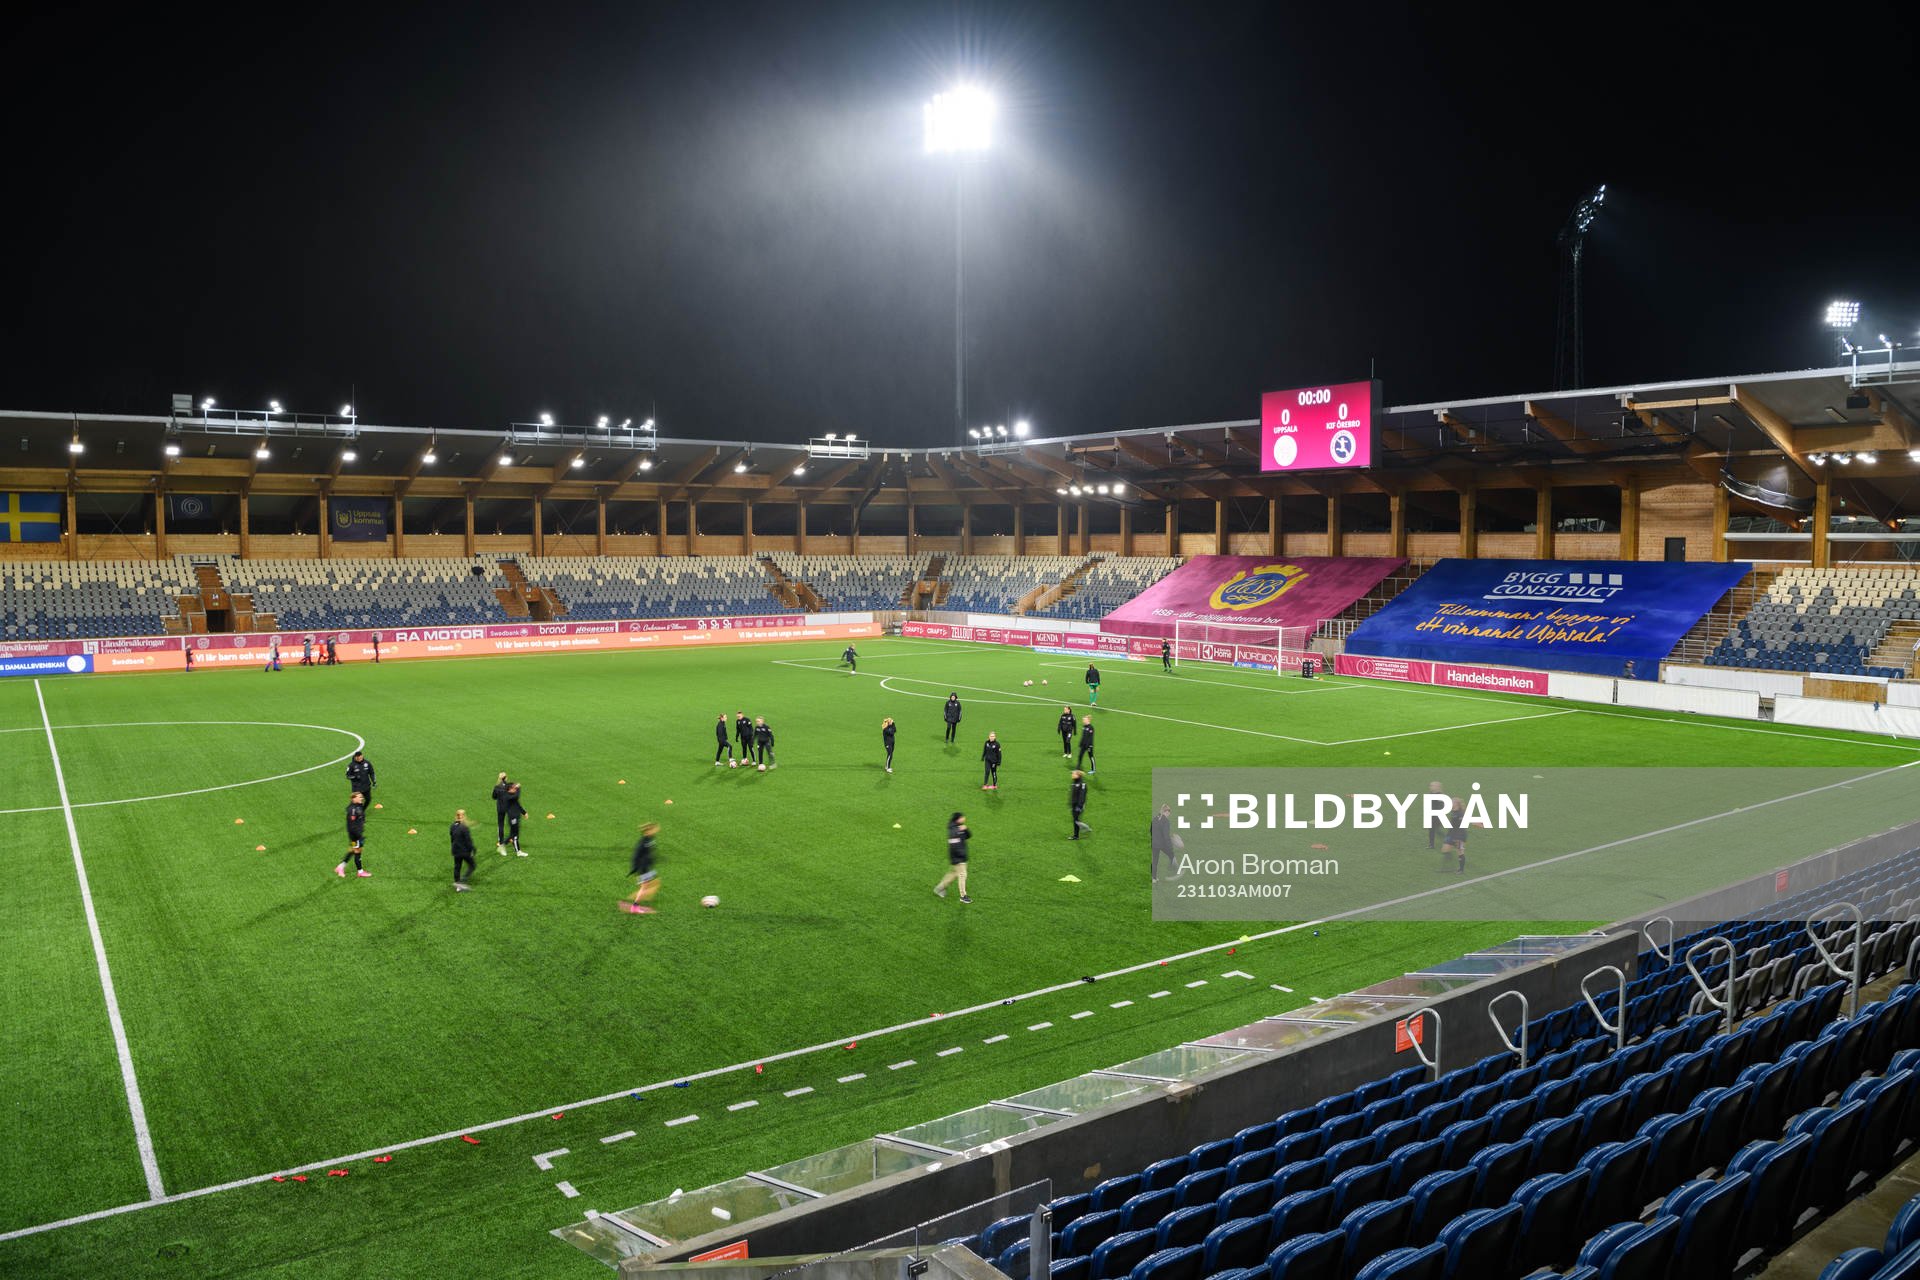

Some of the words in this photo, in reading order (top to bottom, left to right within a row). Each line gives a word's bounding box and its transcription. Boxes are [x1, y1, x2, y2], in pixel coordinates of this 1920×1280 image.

[1298, 389, 1331, 406] 00:00
[1281, 409, 1290, 425] 0
[1338, 403, 1348, 420] 0
[1273, 425, 1298, 434] UPPSALA
[1326, 422, 1336, 430] KIF
[1336, 419, 1361, 429] ÖREBRO
[1503, 572, 1563, 584] BYGG
[1491, 584, 1624, 598] CONSTRUCT
[1434, 603, 1543, 621] Tillsammans
[1546, 607, 1609, 627] bygger
[1610, 614, 1636, 625] vi
[396, 632, 420, 642] RA
[423, 629, 484, 641] MOTOR
[490, 629, 519, 637] Swedbank
[540, 625, 566, 634] brand
[1415, 617, 1445, 632] ett
[1442, 621, 1522, 640] vinnande
[1525, 622, 1621, 645] Uppsala!
[1036, 633, 1059, 643] AGENDA
[101, 640, 165, 649] Länsförsäkringar
[5, 662, 65, 671] DAMALLSVENSKAN
[1447, 669, 1534, 684] Handelsbanken
